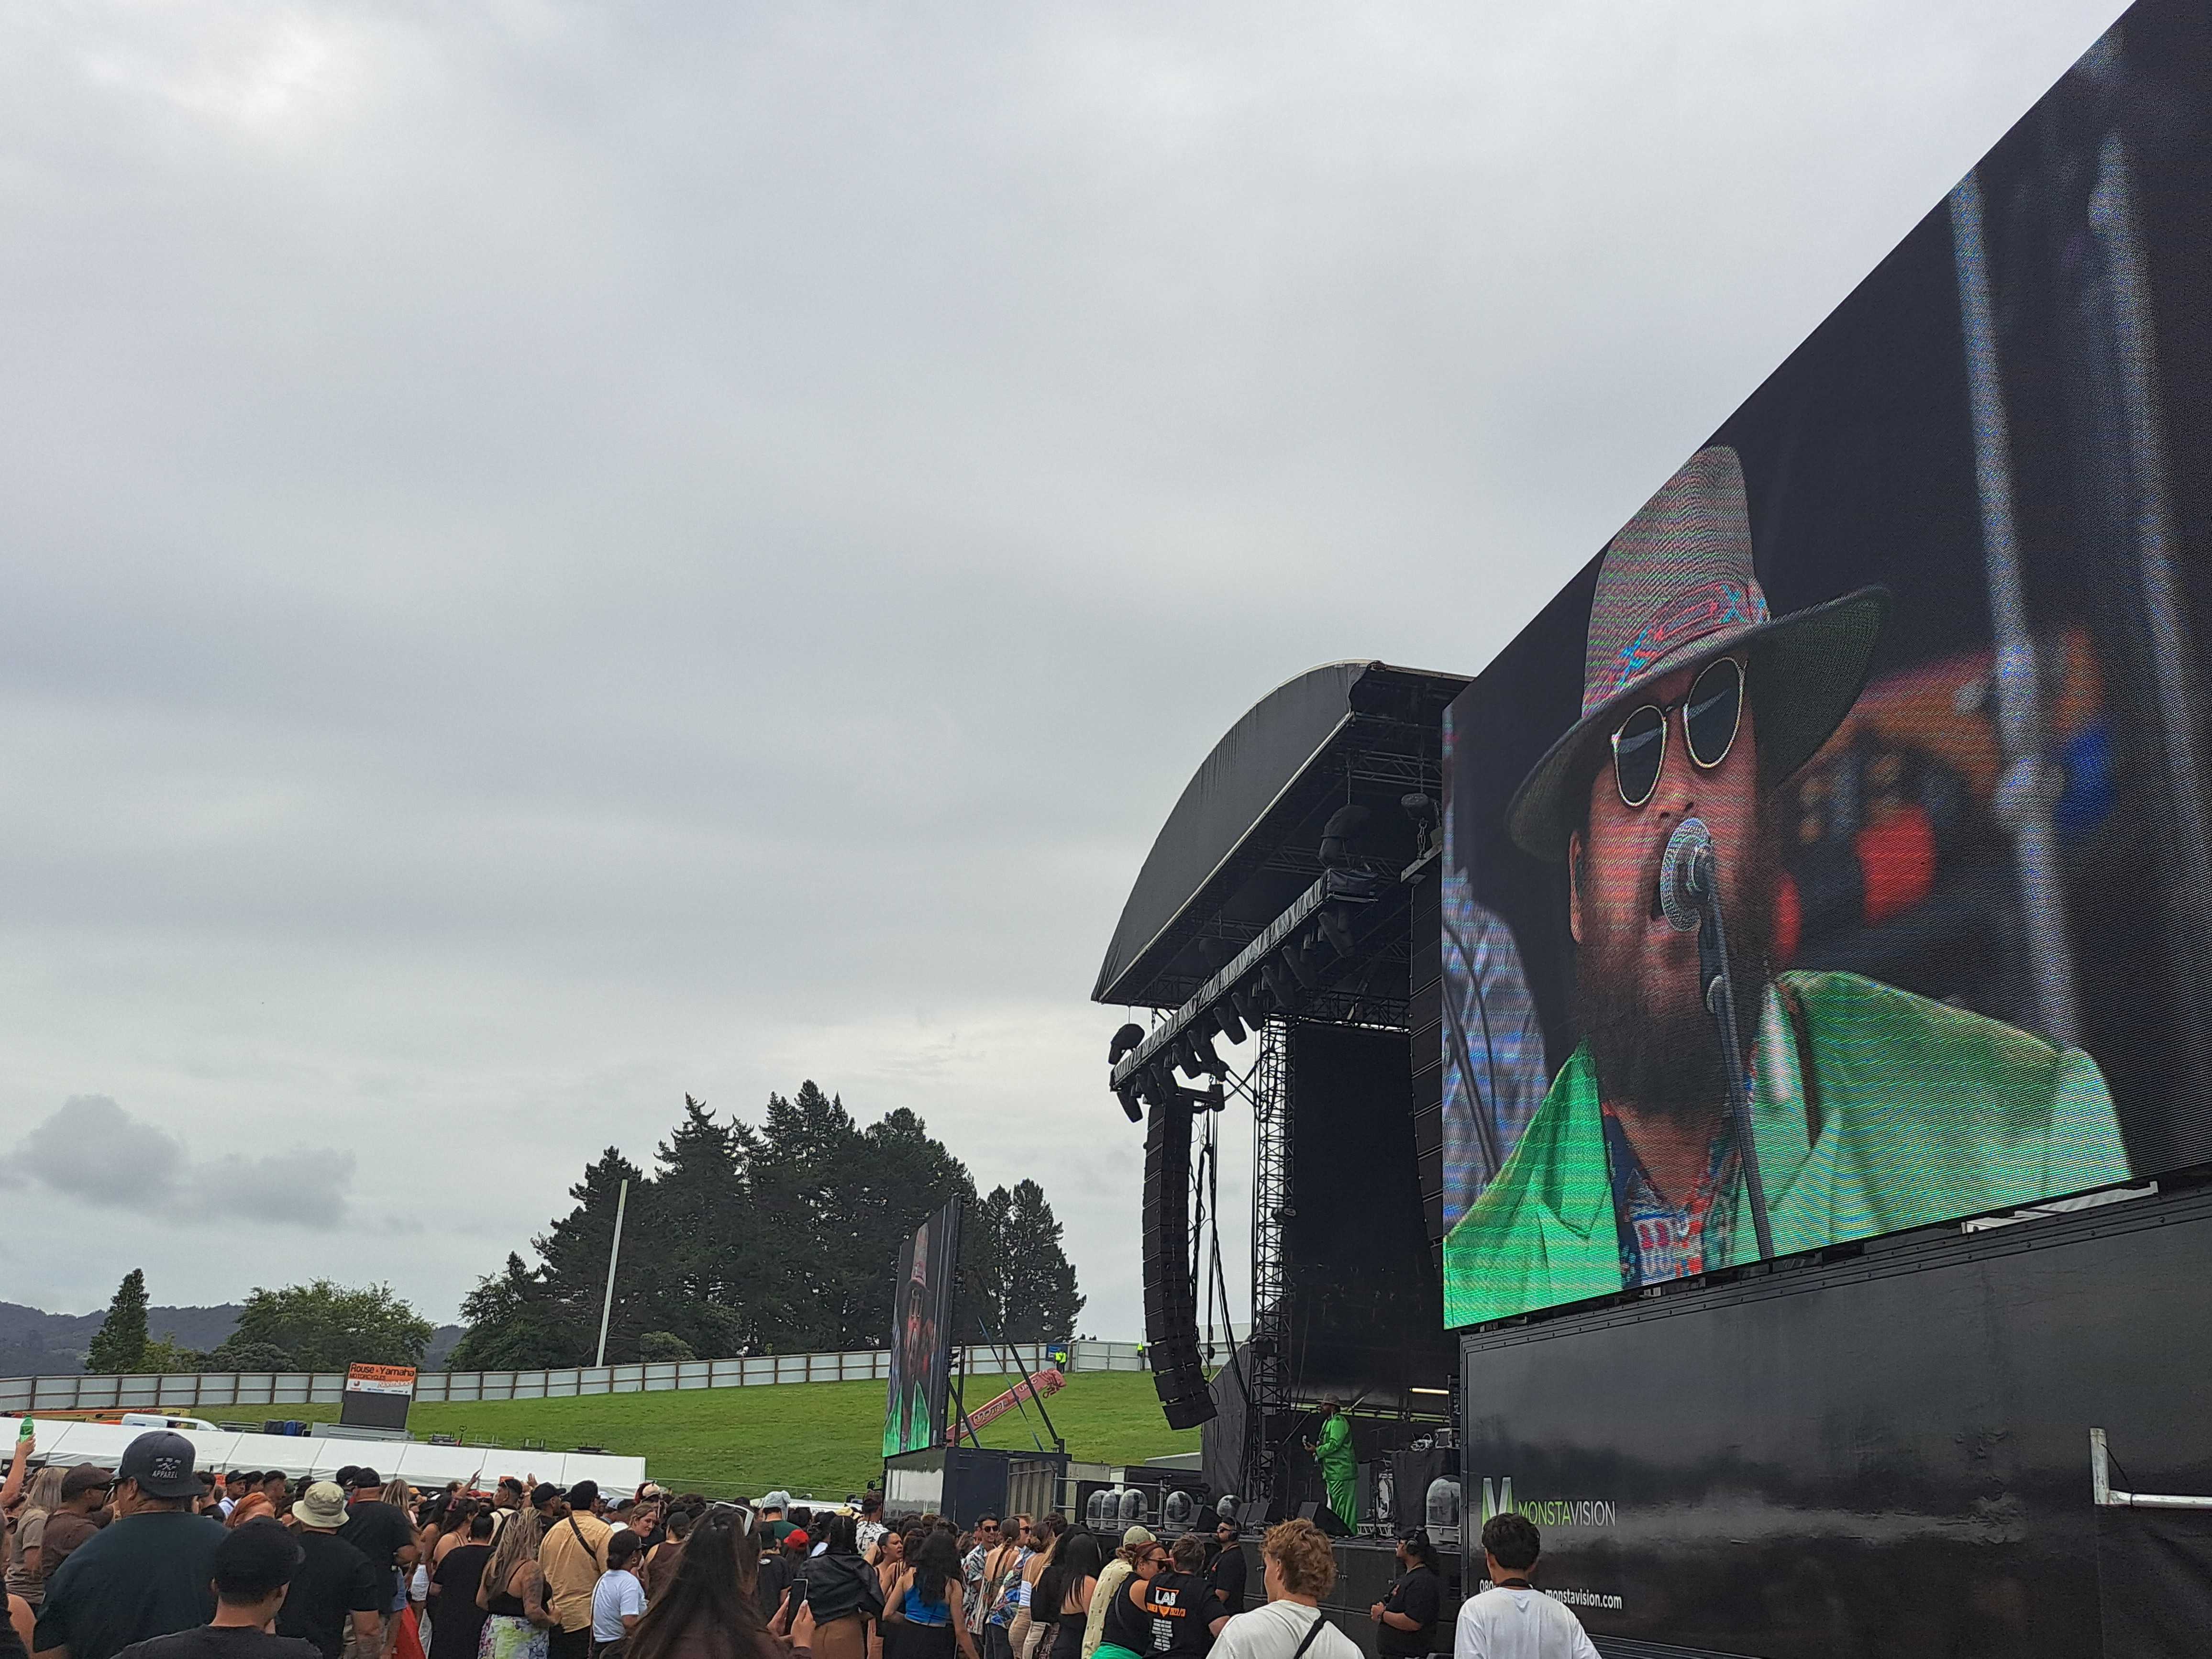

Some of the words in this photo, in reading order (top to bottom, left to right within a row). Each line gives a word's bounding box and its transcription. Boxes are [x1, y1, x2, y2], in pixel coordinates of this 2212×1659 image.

[350, 1363, 375, 1373] Rouse
[380, 1366, 415, 1377] Yamaha
[1018, 1378, 1038, 1393] UNC
[152, 1470, 177, 1479] APPAREL
[1518, 1500, 1616, 1526] MONSTAVISION
[1155, 1590, 1176, 1606] LAB
